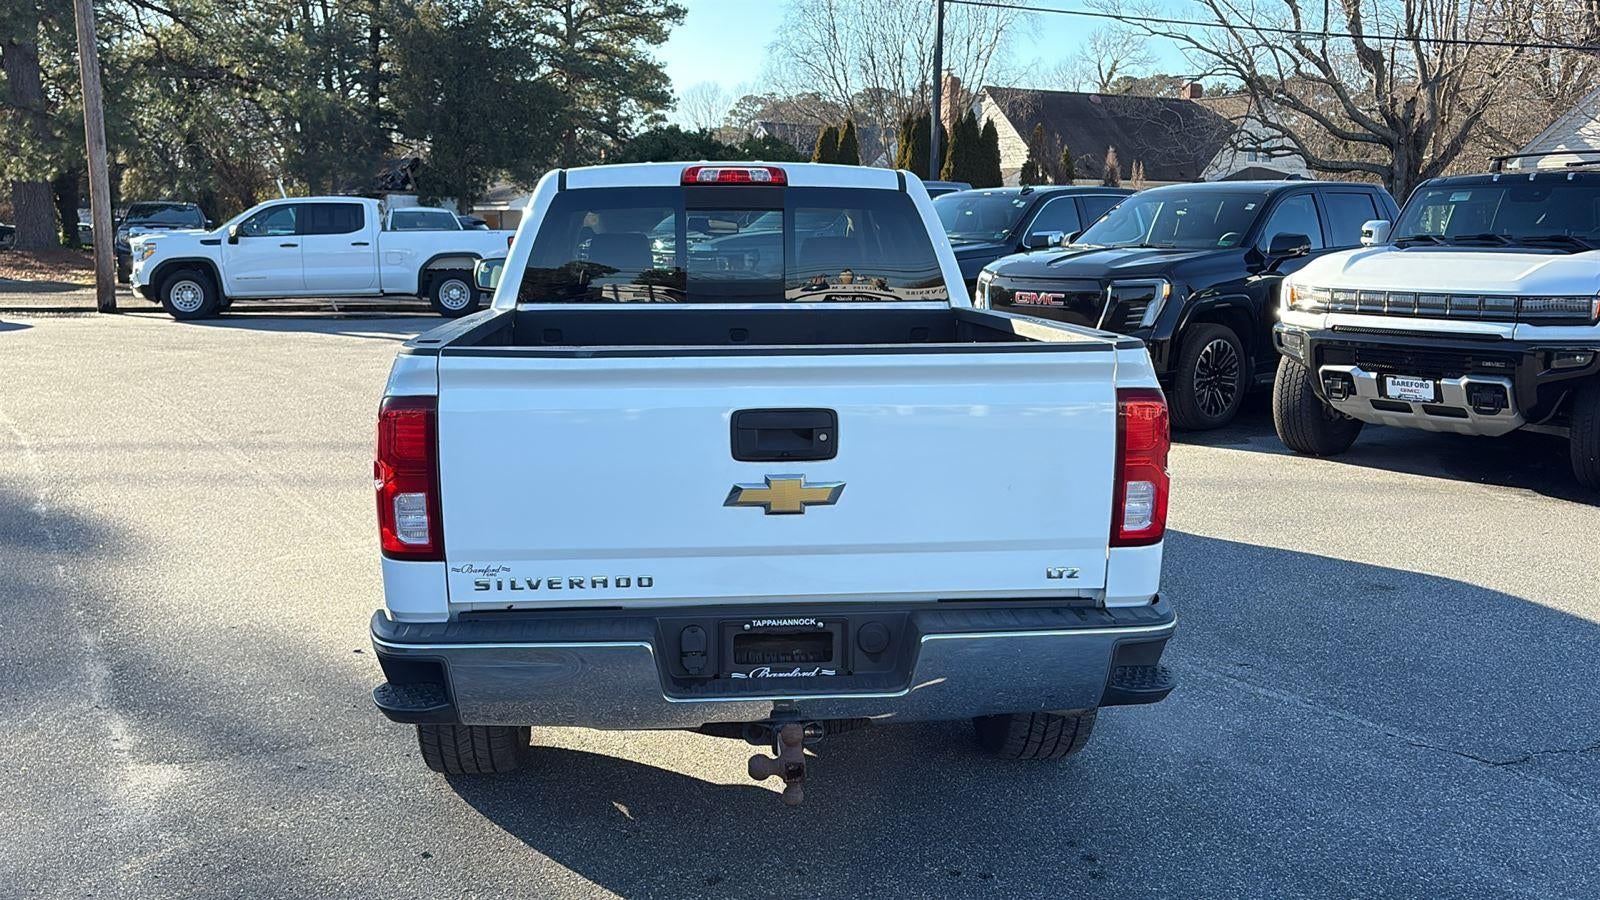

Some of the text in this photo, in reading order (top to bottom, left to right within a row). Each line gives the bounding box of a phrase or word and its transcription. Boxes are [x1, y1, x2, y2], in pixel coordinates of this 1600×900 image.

[1015, 291, 1065, 306] GMC
[1391, 379, 1430, 389] BAREFORD
[461, 564, 502, 576] Bareford
[1046, 566, 1080, 579] LTZ
[474, 575, 654, 591] SILVERADO
[752, 618, 816, 627] TAPPAHANNOCK
